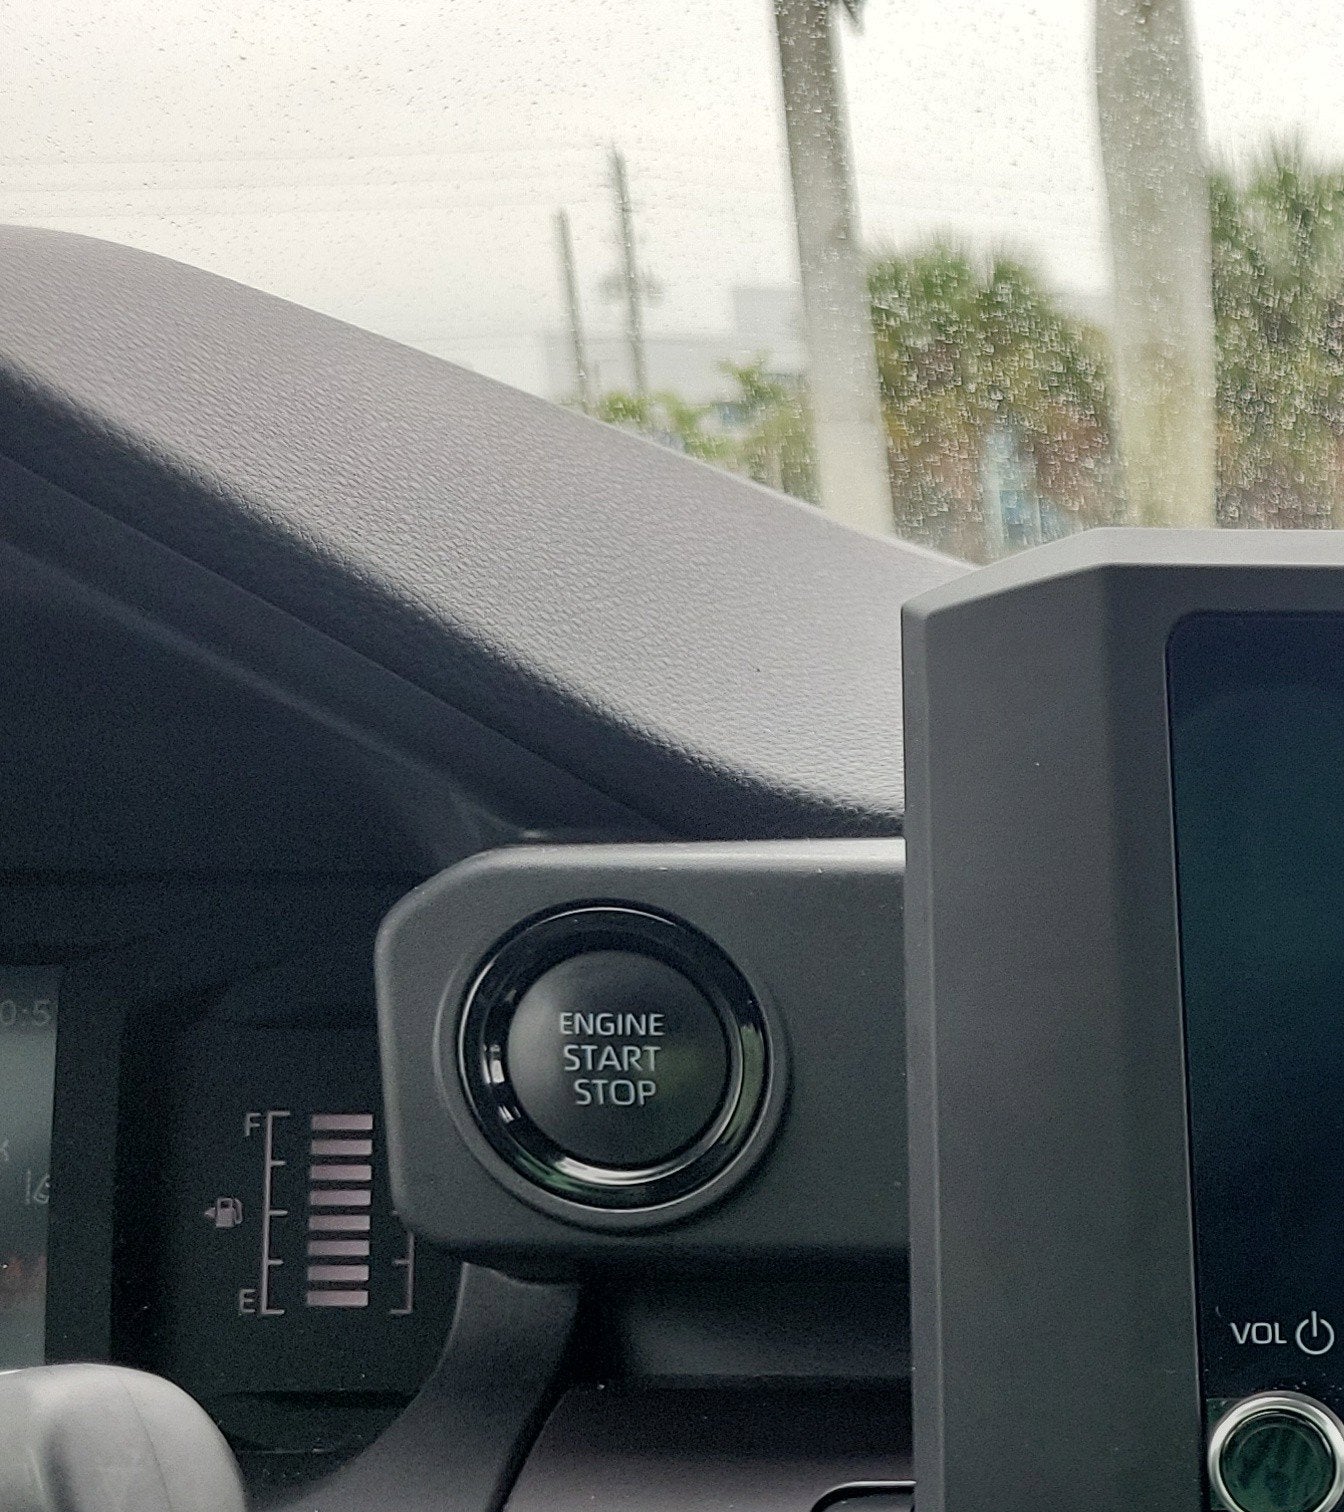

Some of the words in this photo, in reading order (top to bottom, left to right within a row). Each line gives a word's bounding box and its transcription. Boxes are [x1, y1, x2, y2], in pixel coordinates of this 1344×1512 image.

[559, 1012, 665, 1036] ENGINE
[563, 1044, 662, 1072] START
[574, 1079, 656, 1106] STOP
[244, 1112, 262, 1137] F
[239, 1289, 256, 1314] E
[1230, 1322, 1287, 1346] VOL
